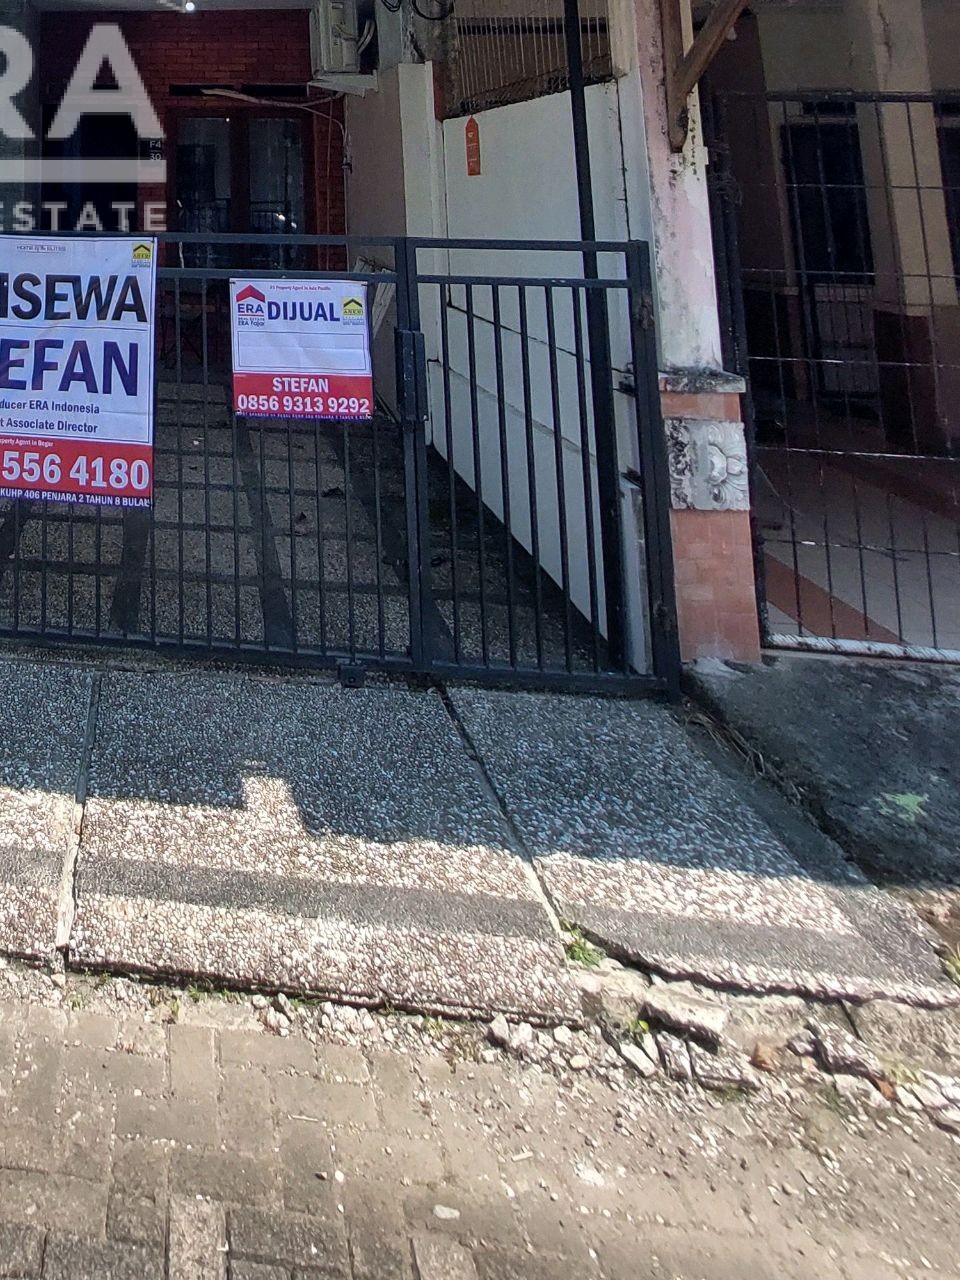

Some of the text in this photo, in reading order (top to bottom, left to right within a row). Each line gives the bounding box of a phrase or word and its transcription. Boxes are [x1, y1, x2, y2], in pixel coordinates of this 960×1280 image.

[237, 303, 265, 314] ERA
[267, 301, 340, 322] DIJUAL
[272, 377, 329, 393] STEFAN
[29, 400, 49, 410] ERA
[51, 401, 100, 414] Indonesia
[237, 394, 370, 413] 0856 9313 9292
[6, 418, 54, 430] Associate
[57, 421, 98, 433] Director
[15, 438, 31, 446] Agent
[69, 455, 149, 490] 4180
[0, 488, 24, 498] KUHP
[24, 490, 40, 499] 406
[41, 492, 77, 503] PENJARA
[78, 494, 84, 503] 2
[86, 495, 113, 505] TAHUN
[114, 496, 121, 505] 8
